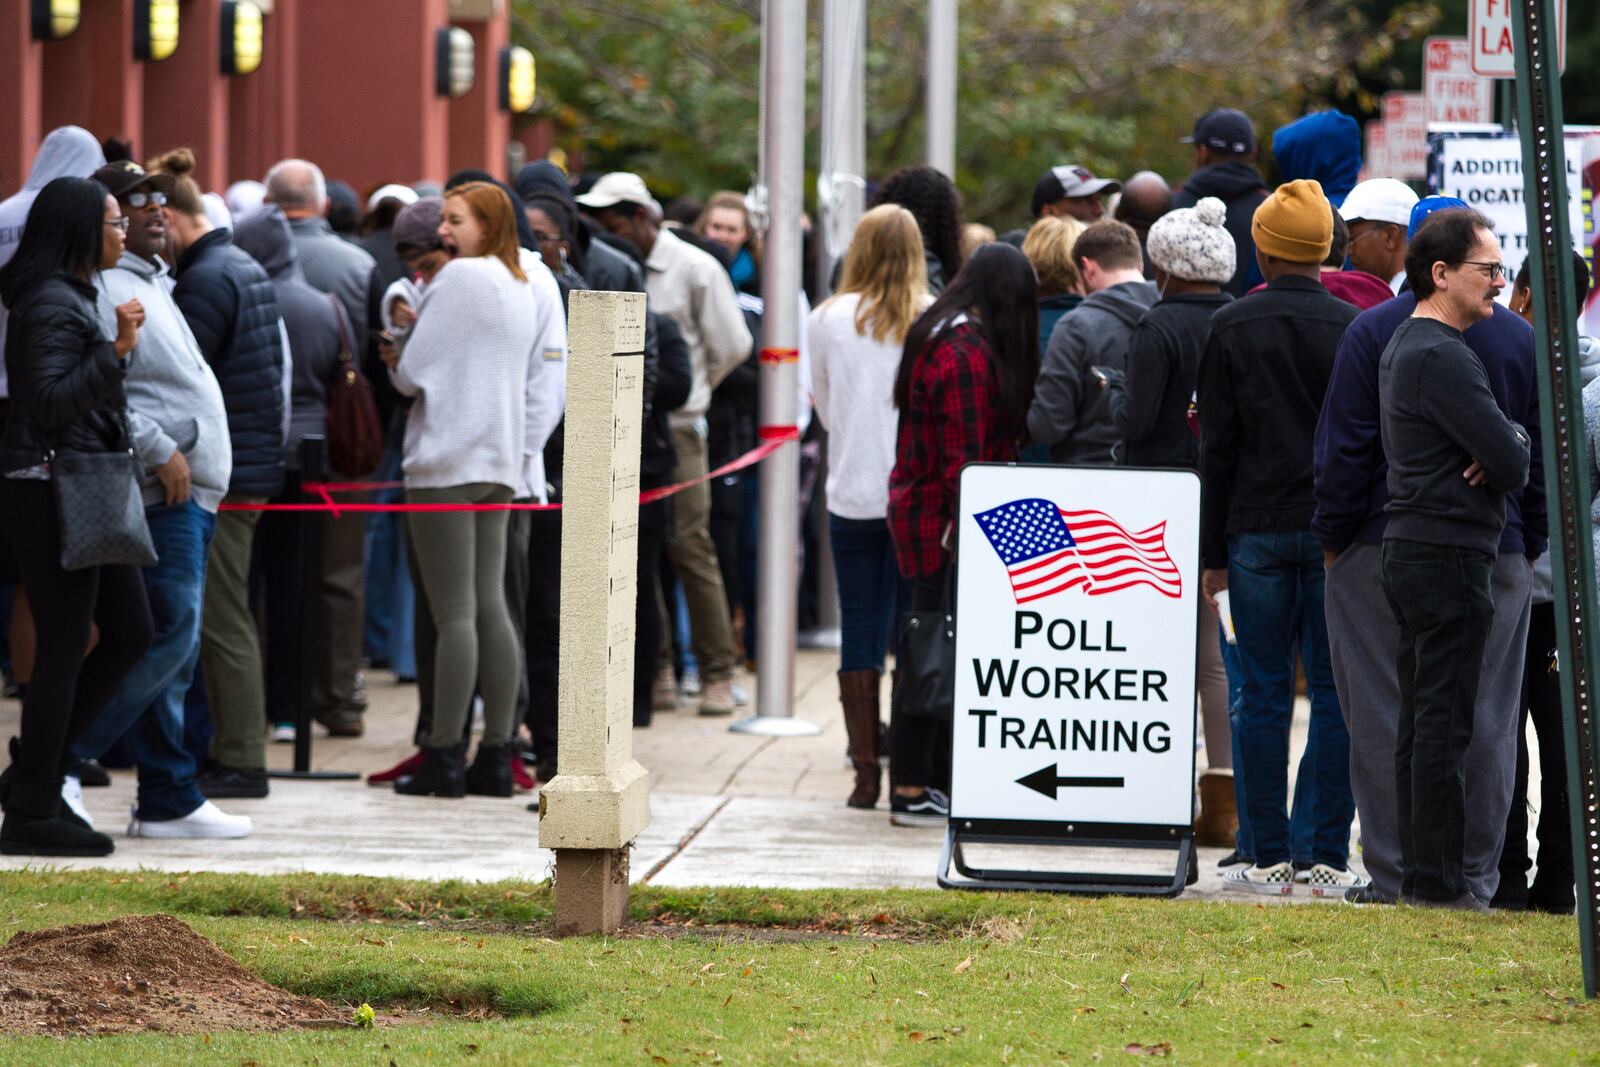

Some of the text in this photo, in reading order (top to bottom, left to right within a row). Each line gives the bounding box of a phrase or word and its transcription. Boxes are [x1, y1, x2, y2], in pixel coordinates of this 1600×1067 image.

[1481, 26, 1513, 54] LA
[1453, 160, 1577, 174] ADDITIL
[1015, 611, 1126, 651] POLL
[973, 659, 1169, 701] WORKER
[968, 710, 1170, 753] TRAINING
